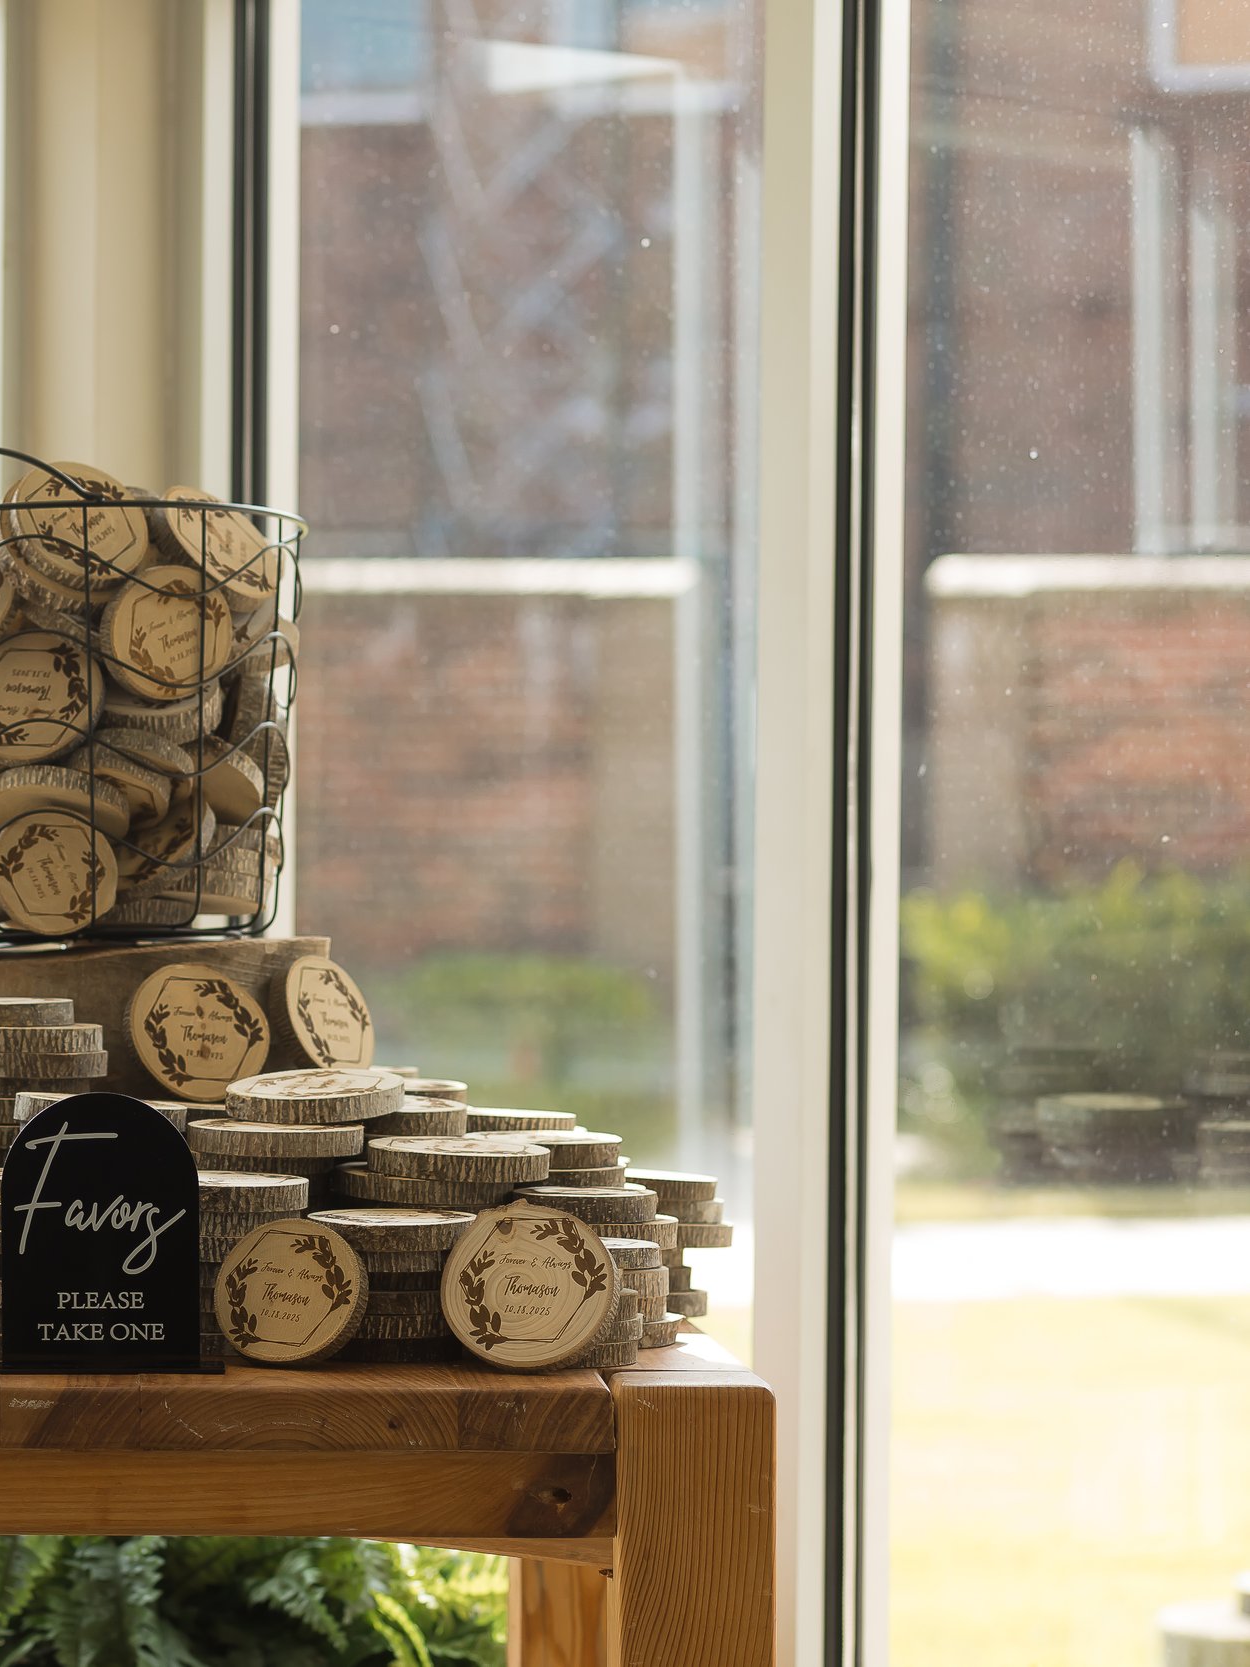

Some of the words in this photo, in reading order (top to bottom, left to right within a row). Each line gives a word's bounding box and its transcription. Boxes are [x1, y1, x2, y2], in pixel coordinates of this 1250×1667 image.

[66, 512, 106, 539] Thason
[4, 682, 51, 701] Thomason
[180, 1024, 228, 1045] Thomason
[14, 1121, 186, 1275] Favors
[261, 1261, 285, 1273] Forever
[288, 1268, 294, 1278] &
[297, 1268, 323, 1282] Always
[499, 1253, 526, 1265] Forever
[530, 1257, 538, 1268] &
[541, 1256, 572, 1270] Always
[262, 1281, 310, 1306] Thomason
[504, 1274, 560, 1298] Thomason
[57, 1292, 145, 1309] PLEASE
[504, 1304, 551, 1316] 10.18.2025
[260, 1308, 301, 1322] 10.18.2025
[38, 1323, 104, 1341] TAKE
[110, 1323, 165, 1341] ONE
